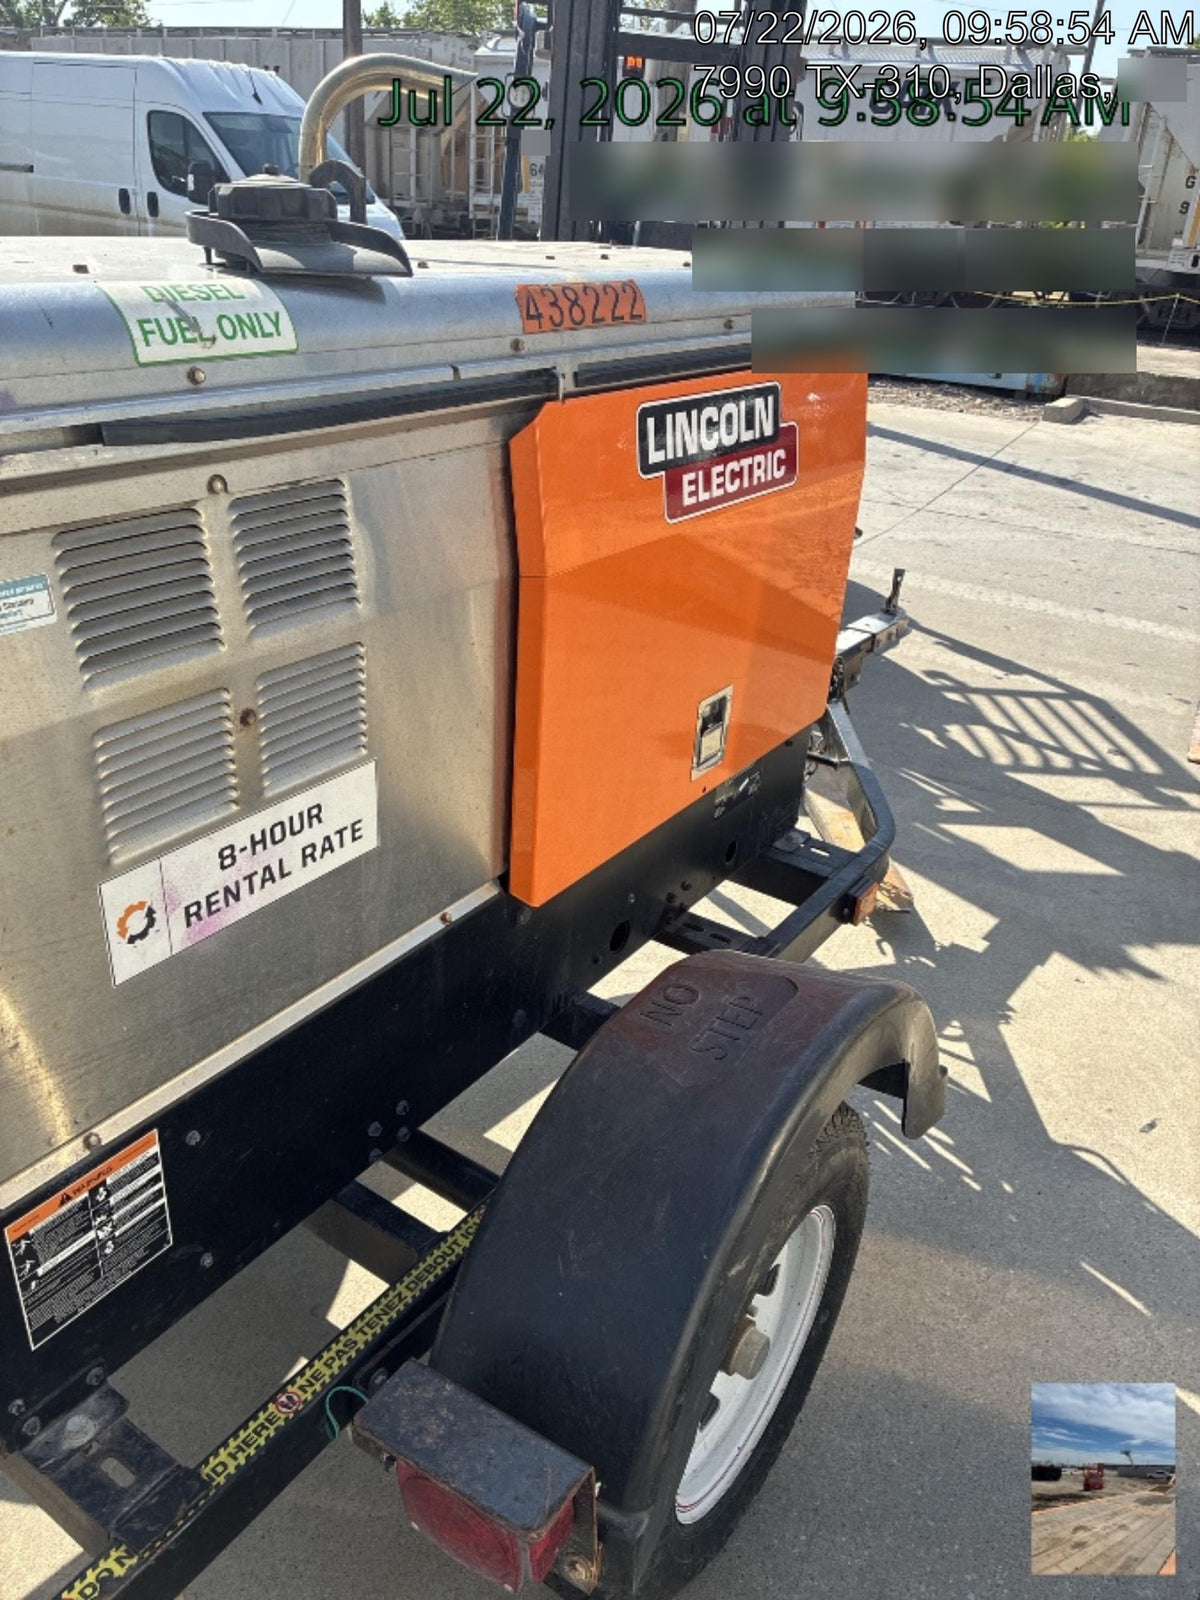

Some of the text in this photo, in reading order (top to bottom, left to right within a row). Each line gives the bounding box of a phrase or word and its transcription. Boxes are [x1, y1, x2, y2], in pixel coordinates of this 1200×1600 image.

[141, 283, 246, 302] DIESEL
[526, 283, 642, 329] 438222
[137, 311, 282, 347] FUEL ONLY
[646, 394, 774, 465] LINCOLN
[682, 448, 787, 507] ELECTRIC
[218, 803, 323, 871] 8-HOUR
[184, 818, 363, 928] RENTAL RATE
[640, 984, 700, 1026] NO
[689, 996, 764, 1061] STEP
[297, 1367, 325, 1393] NE
[325, 1338, 358, 1371] PAS
[356, 1292, 410, 1336] TENEZ
[405, 1239, 463, 1292] DEBOUT
[227, 1411, 281, 1461] HERE
